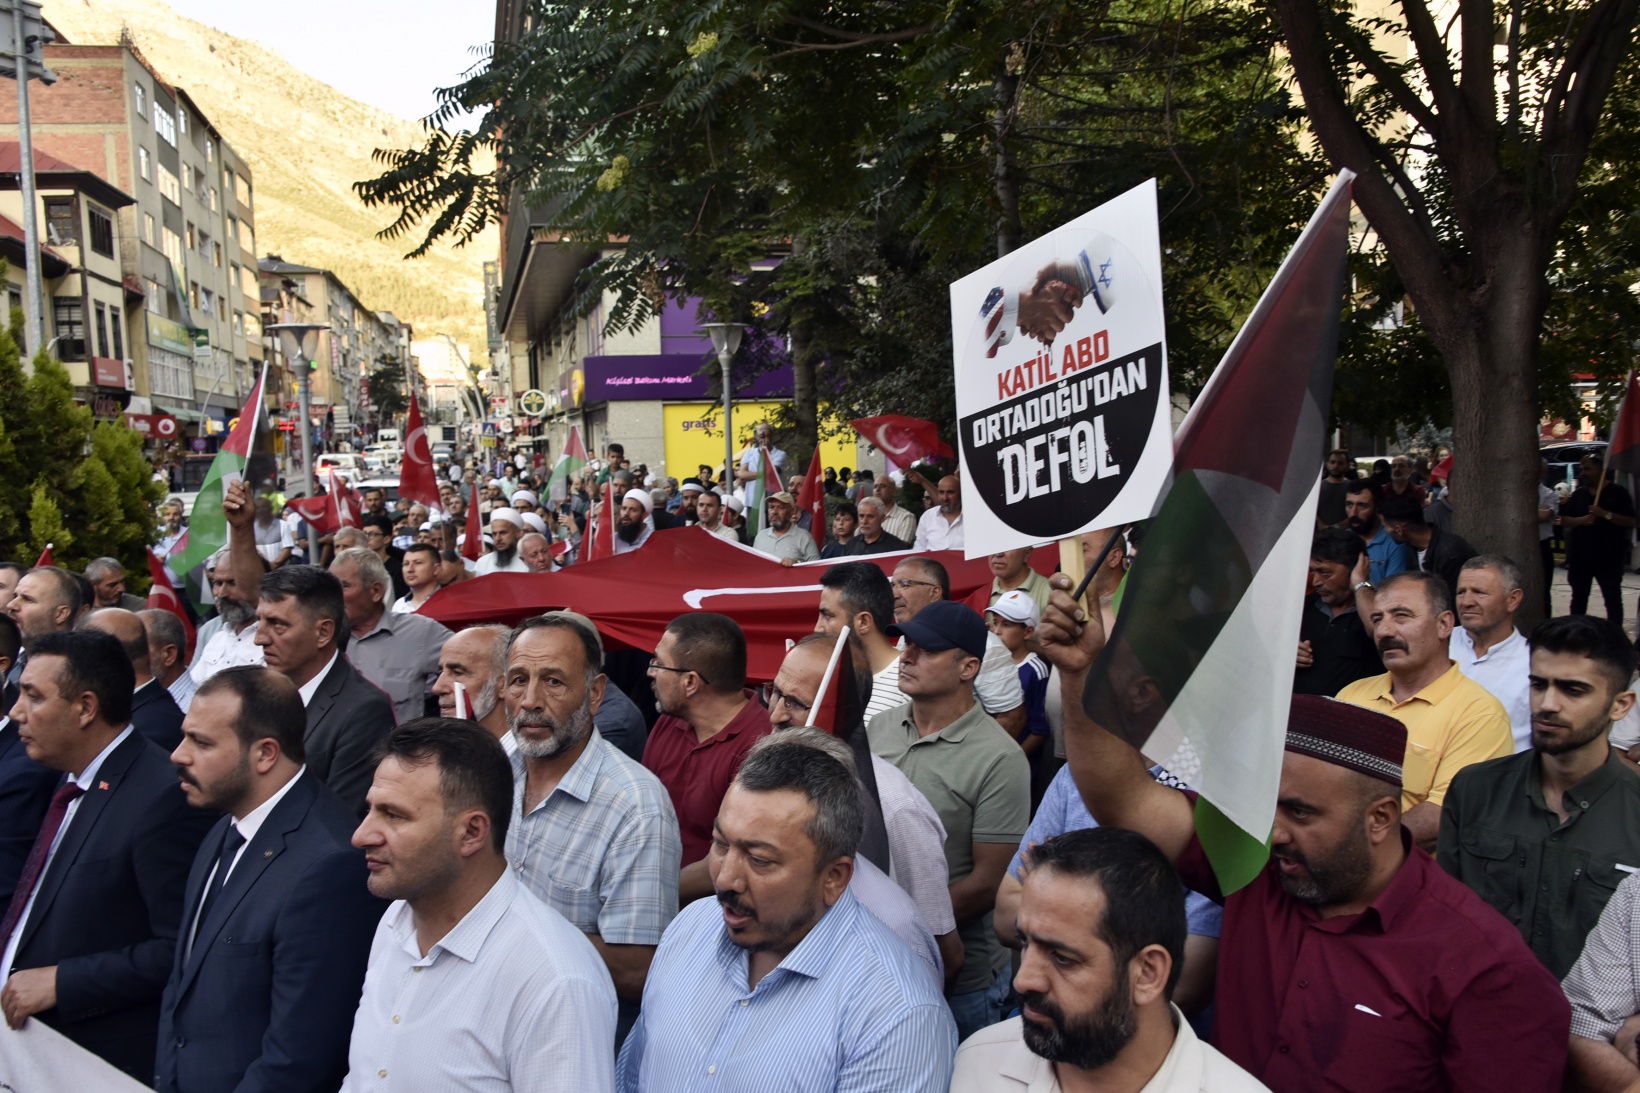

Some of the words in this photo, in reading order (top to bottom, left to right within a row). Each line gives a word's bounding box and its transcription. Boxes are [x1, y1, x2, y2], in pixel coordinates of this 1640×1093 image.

[973, 357, 1147, 448] ORTADOĞU'DAN
[998, 350, 1057, 400] KATİL
[1062, 329, 1109, 376] ABD
[997, 414, 1120, 505] DEFOL
